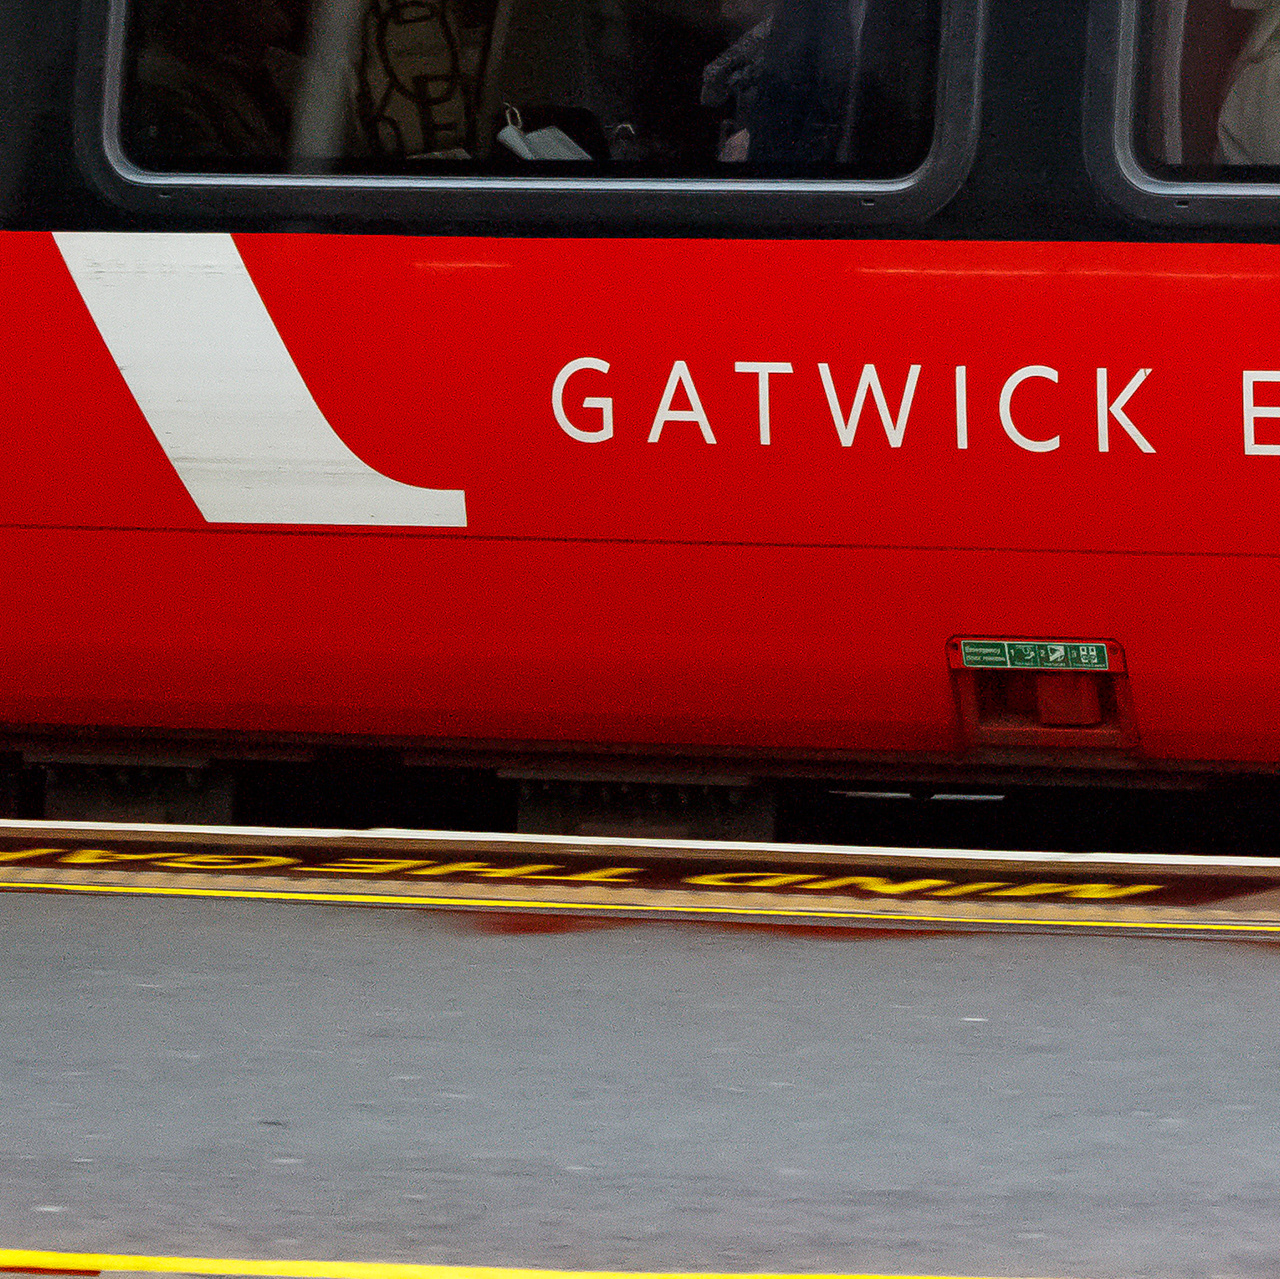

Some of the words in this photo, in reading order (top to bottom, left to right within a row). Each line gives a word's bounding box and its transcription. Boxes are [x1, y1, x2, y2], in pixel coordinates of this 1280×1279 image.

[551, 356, 1157, 454] GATWICK
[292, 858, 641, 882] THE
[685, 872, 1164, 899] MIND
